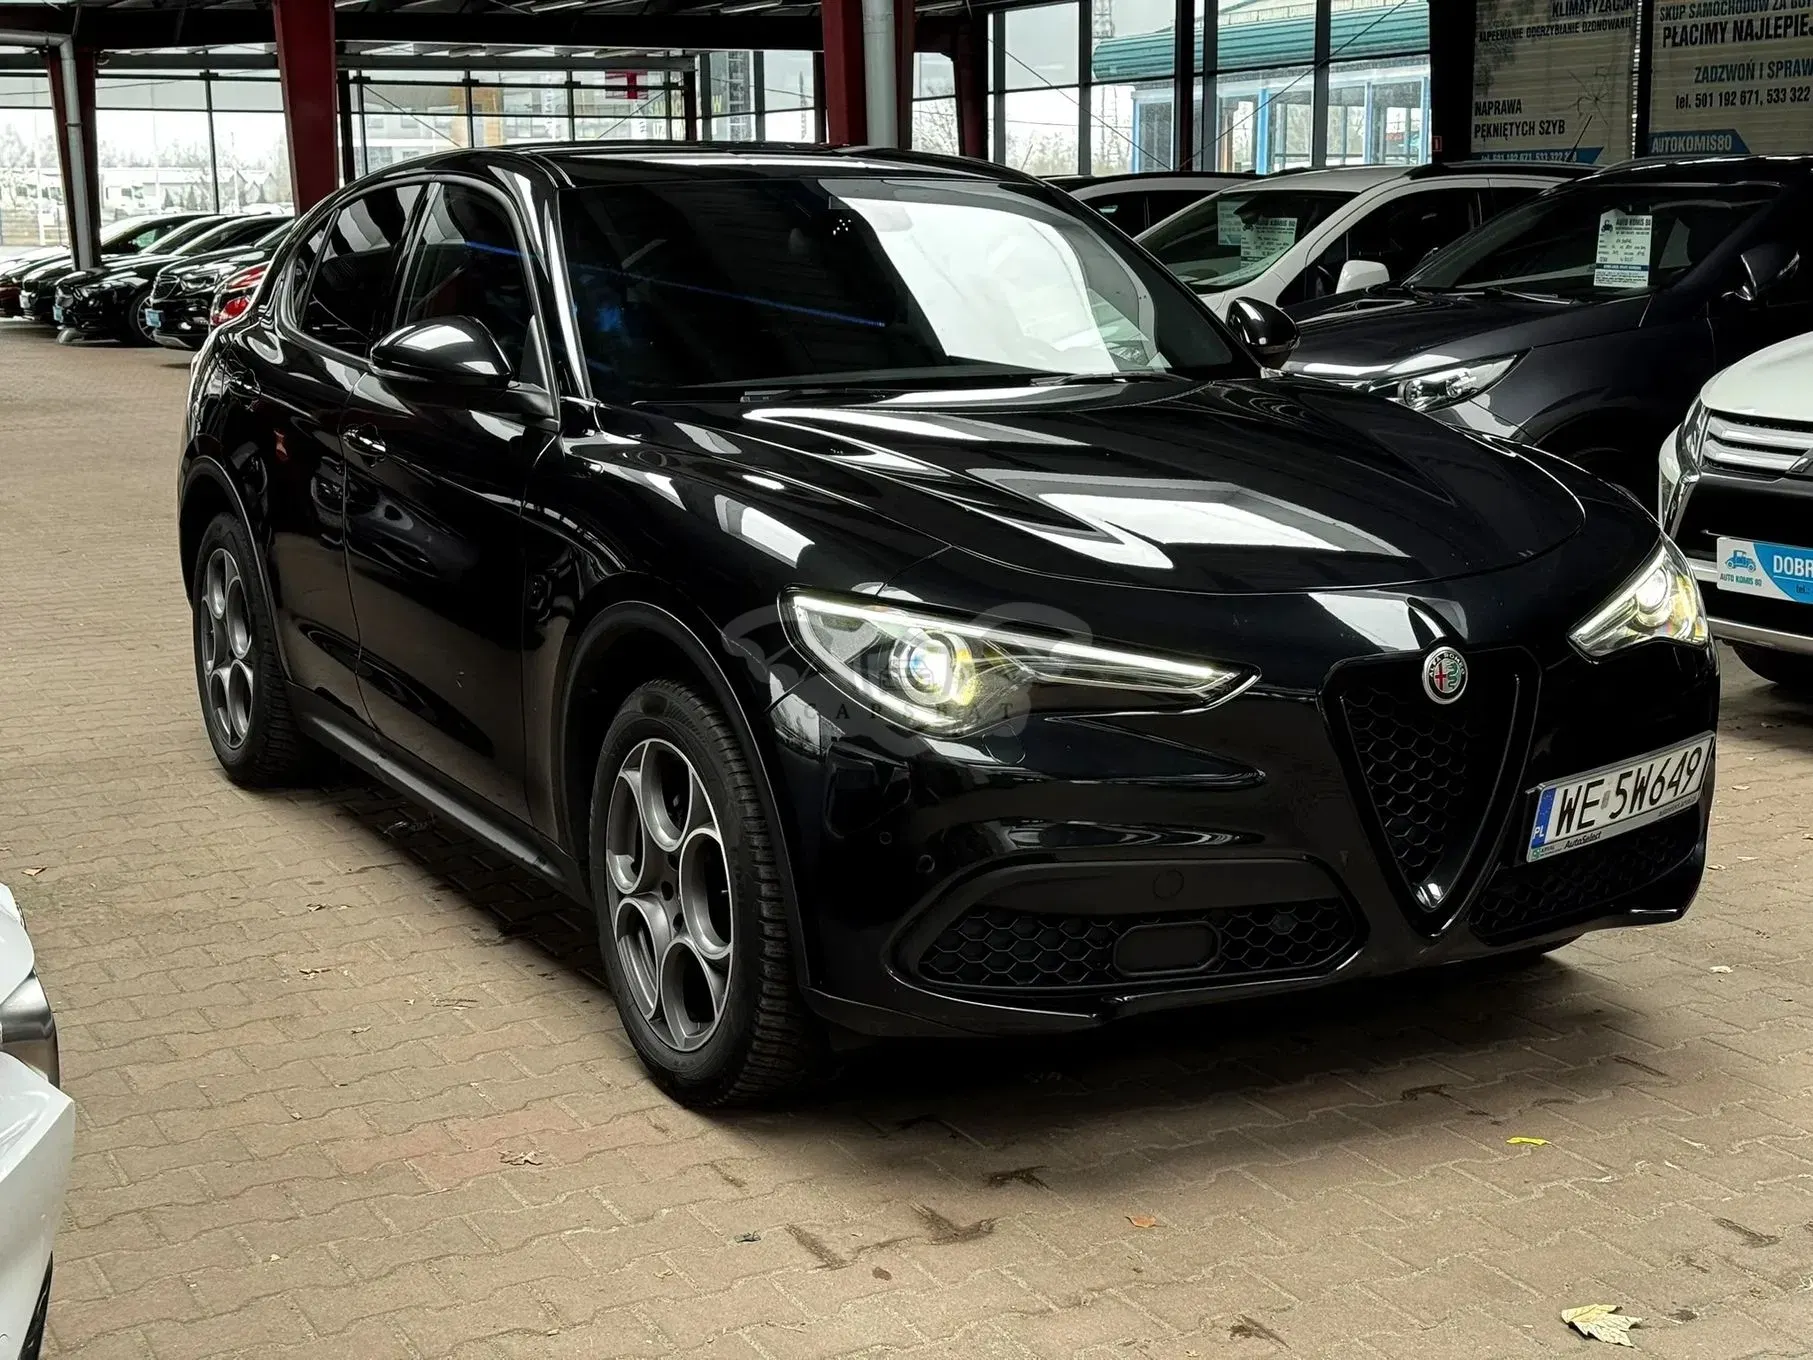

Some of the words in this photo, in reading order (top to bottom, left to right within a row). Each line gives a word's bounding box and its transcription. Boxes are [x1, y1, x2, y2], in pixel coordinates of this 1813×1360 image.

[1660, 5, 1685, 22] SKUP
[1662, 20, 1728, 48] PŁACIMY
[1694, 59, 1755, 84] ZADZWOŃ
[1758, 62, 1763, 80] I
[1474, 99, 1522, 116] NAPRAWA
[1676, 94, 1692, 110] tel.
[1695, 92, 1714, 108] 501
[1718, 91, 1736, 107] 192
[1740, 89, 1763, 106] 671,
[1767, 87, 1786, 104] 533
[1790, 86, 1810, 103] 322
[1474, 121, 1535, 142] PĘKNIĘTYCH
[1539, 119, 1565, 136] SZYB
[1651, 134, 1733, 153] AUTOKOMIS80
[1443, 652, 1465, 675] ROMEO
[1556, 779, 1605, 837] WE
[1609, 747, 1703, 820] 5W649
[1533, 825, 1545, 840] PL
